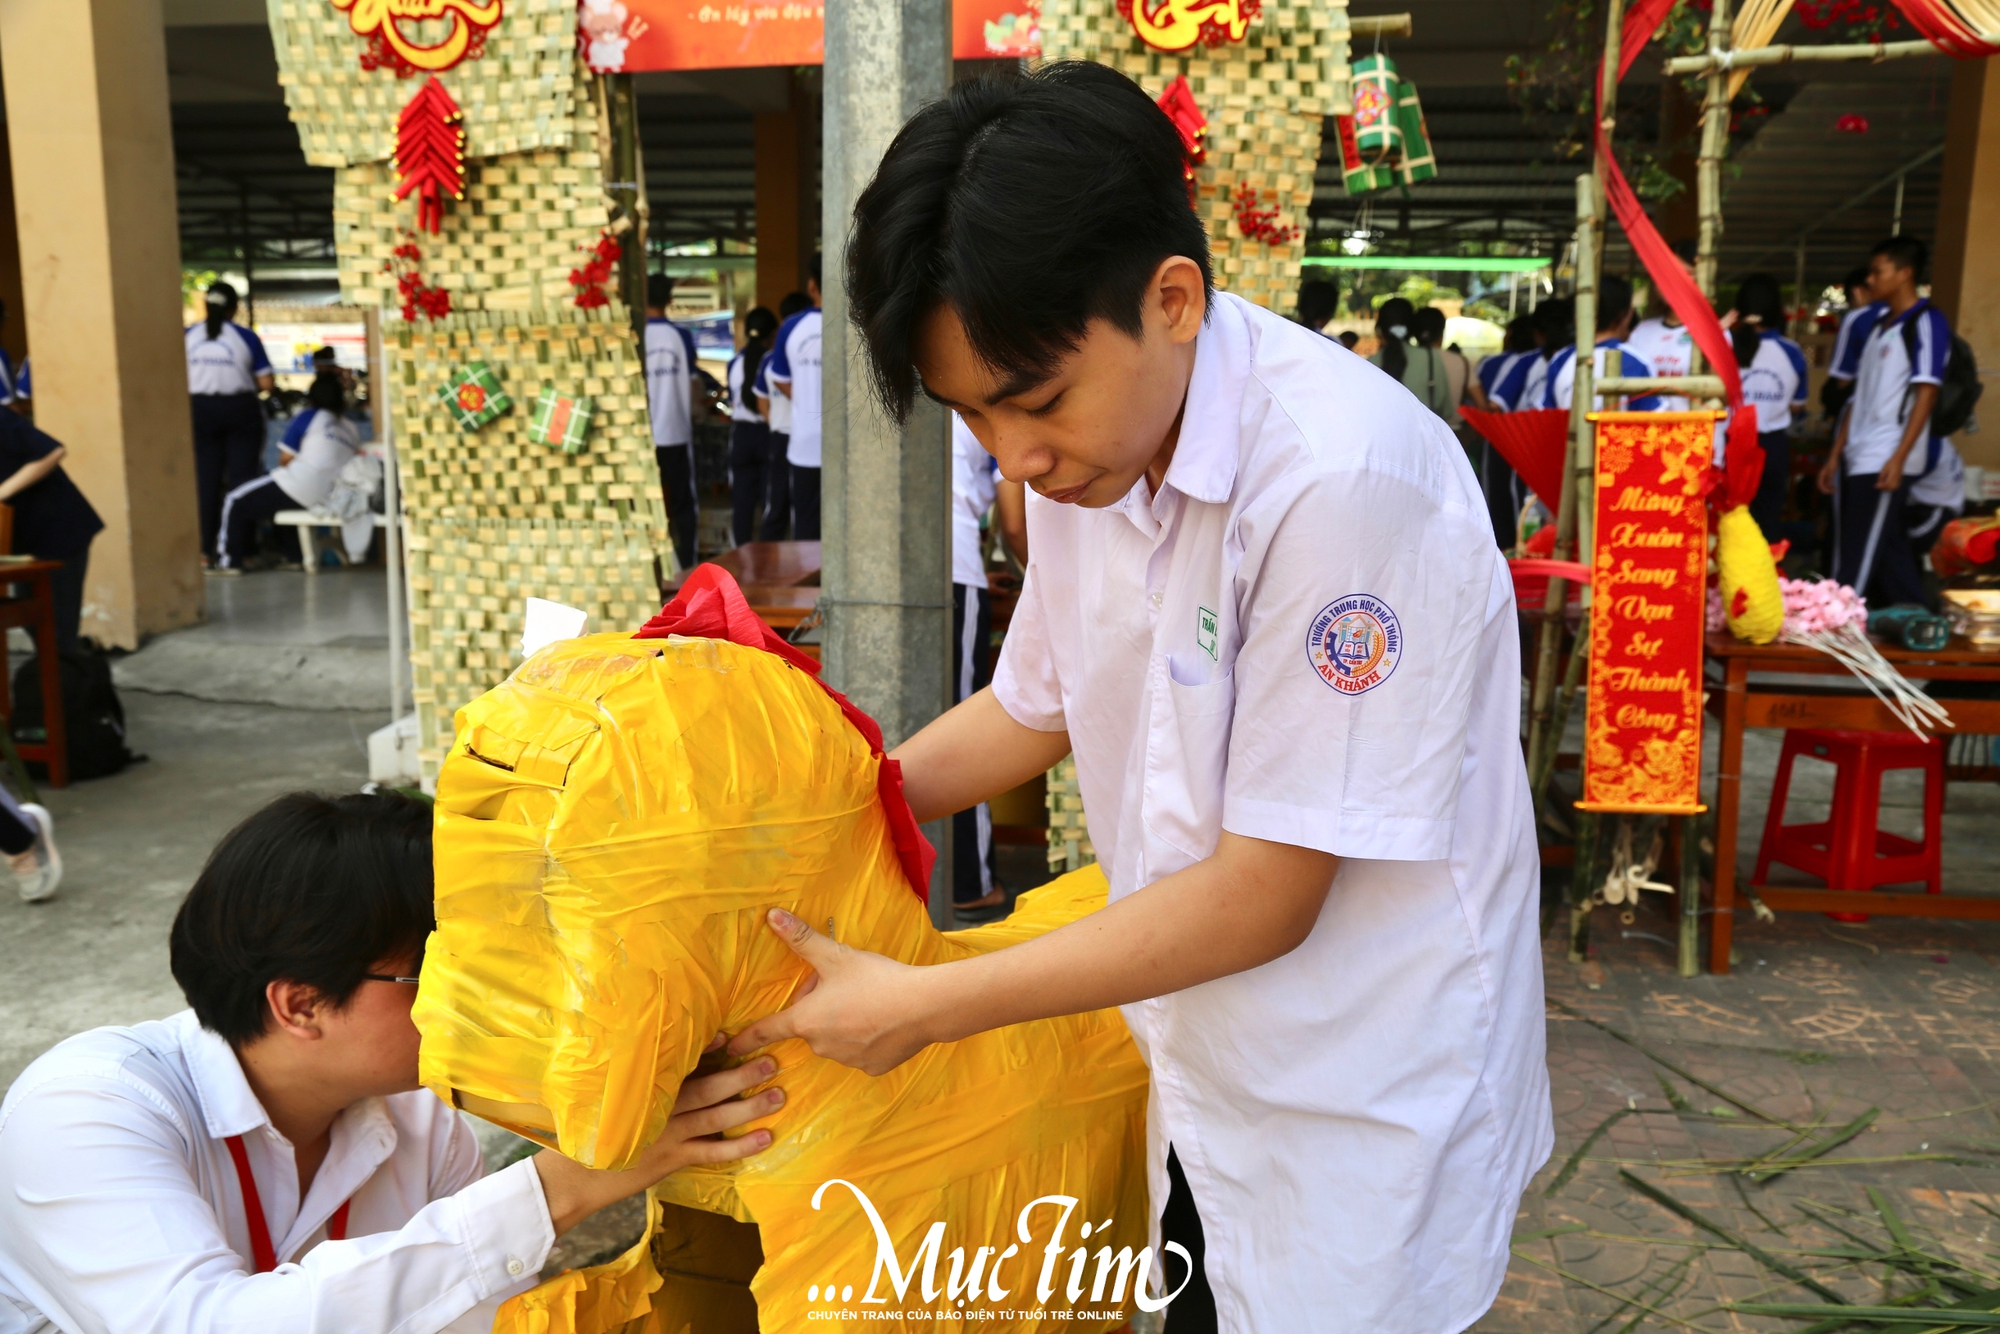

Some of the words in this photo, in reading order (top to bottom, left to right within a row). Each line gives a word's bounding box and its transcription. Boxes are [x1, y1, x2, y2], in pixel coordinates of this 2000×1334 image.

[1609, 486, 1686, 517] Mừng
[1610, 522, 1686, 548] Xuân
[1614, 559, 1679, 590] Sang
[1614, 595, 1674, 624] Vạn
[1311, 615, 1332, 647] TRƯỜNG
[1329, 599, 1358, 618] TRUNG
[1359, 599, 1375, 613] HỌC
[1373, 606, 1395, 624] PHỔ
[1385, 623, 1399, 653] THÔNG
[1624, 631, 1663, 660] Sự
[1317, 663, 1335, 681] AN
[1334, 670, 1382, 692] KHÁNH
[1609, 666, 1691, 692] Thành
[1616, 703, 1678, 734] Công
